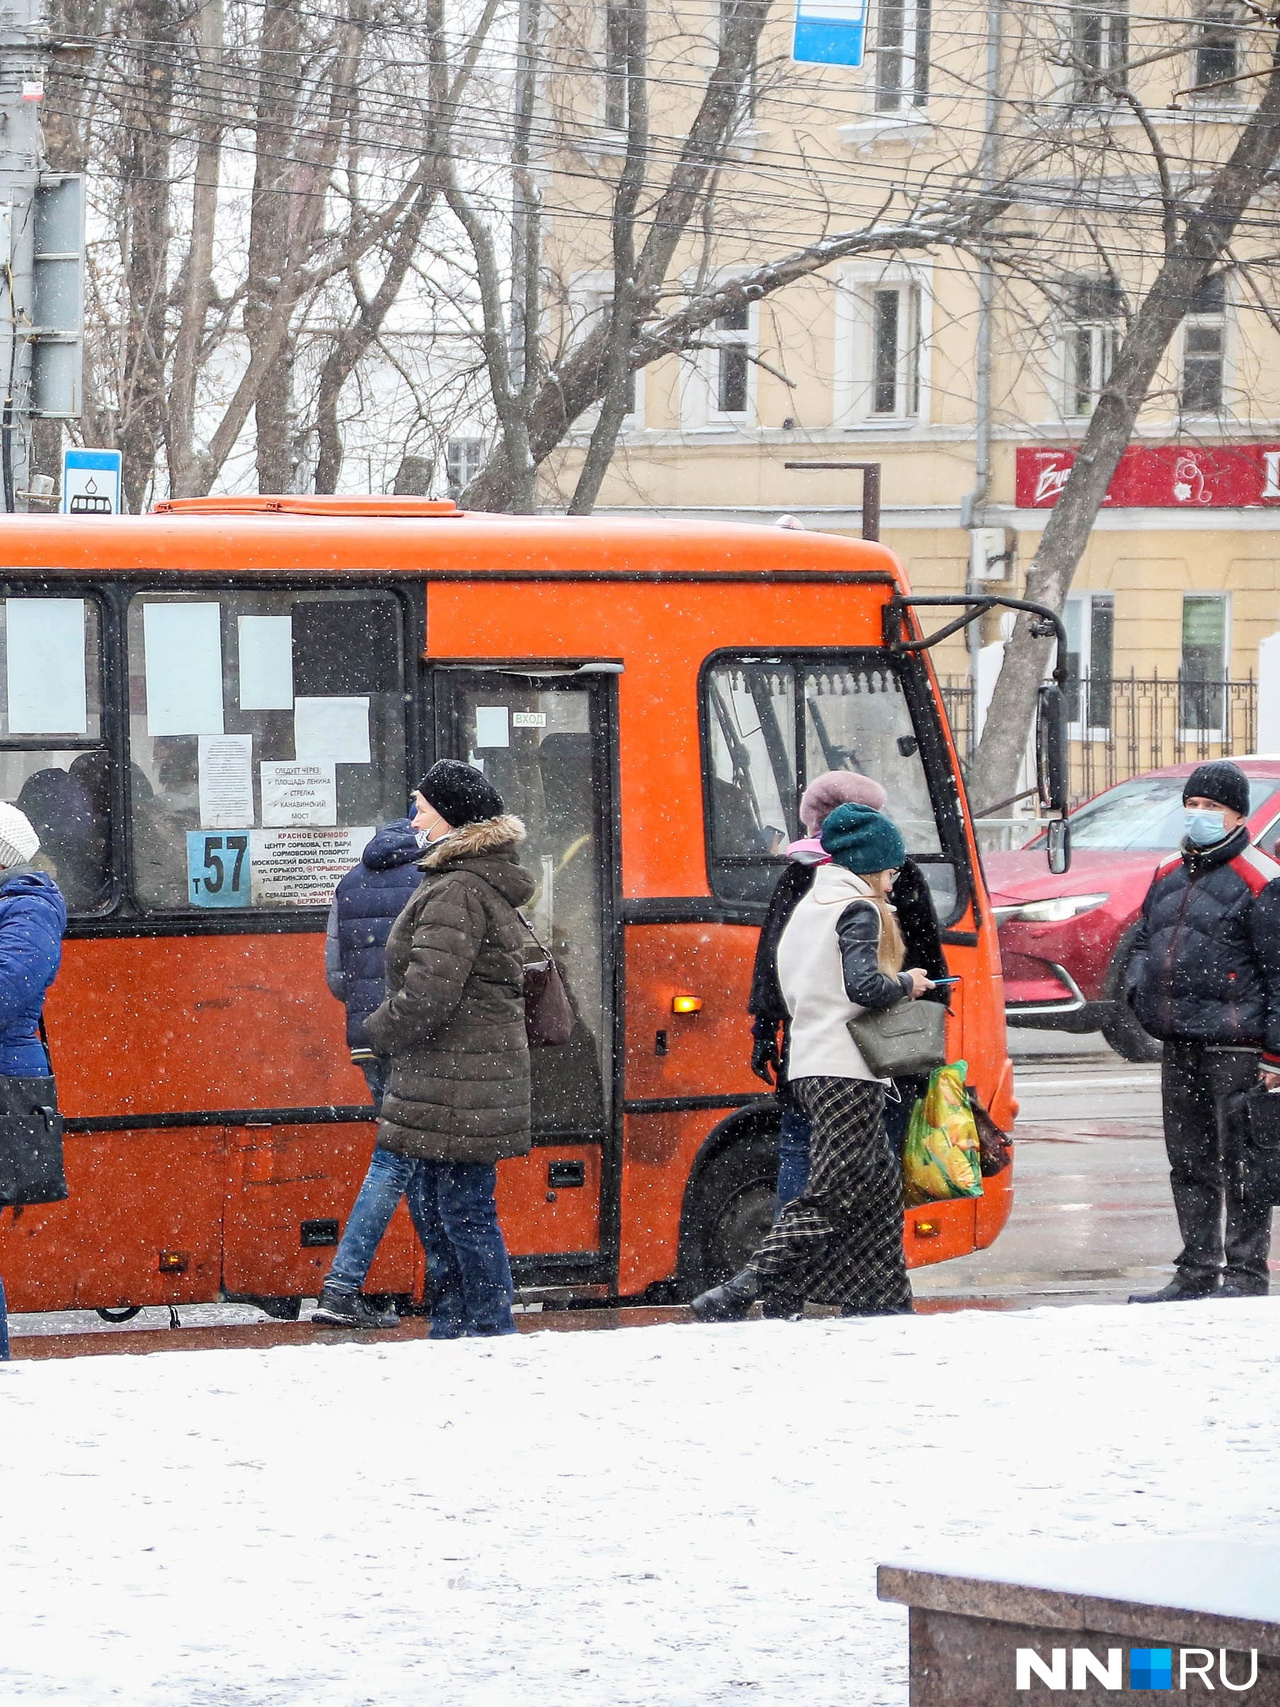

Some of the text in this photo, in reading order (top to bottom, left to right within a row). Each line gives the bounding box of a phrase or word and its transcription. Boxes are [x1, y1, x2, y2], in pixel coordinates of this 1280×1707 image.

[515, 713, 544, 725] ВХОД
[275, 766, 300, 775] СЛЕДУЕТ
[274, 777, 331, 786] ПЛОЩАДЬ ЛЕНИНА
[289, 789, 316, 797] СТРЕЛКА
[291, 812, 309, 820] МОСТ
[277, 831, 349, 840] КРАСНОЕ СОРМОВО
[204, 836, 248, 893] 57
